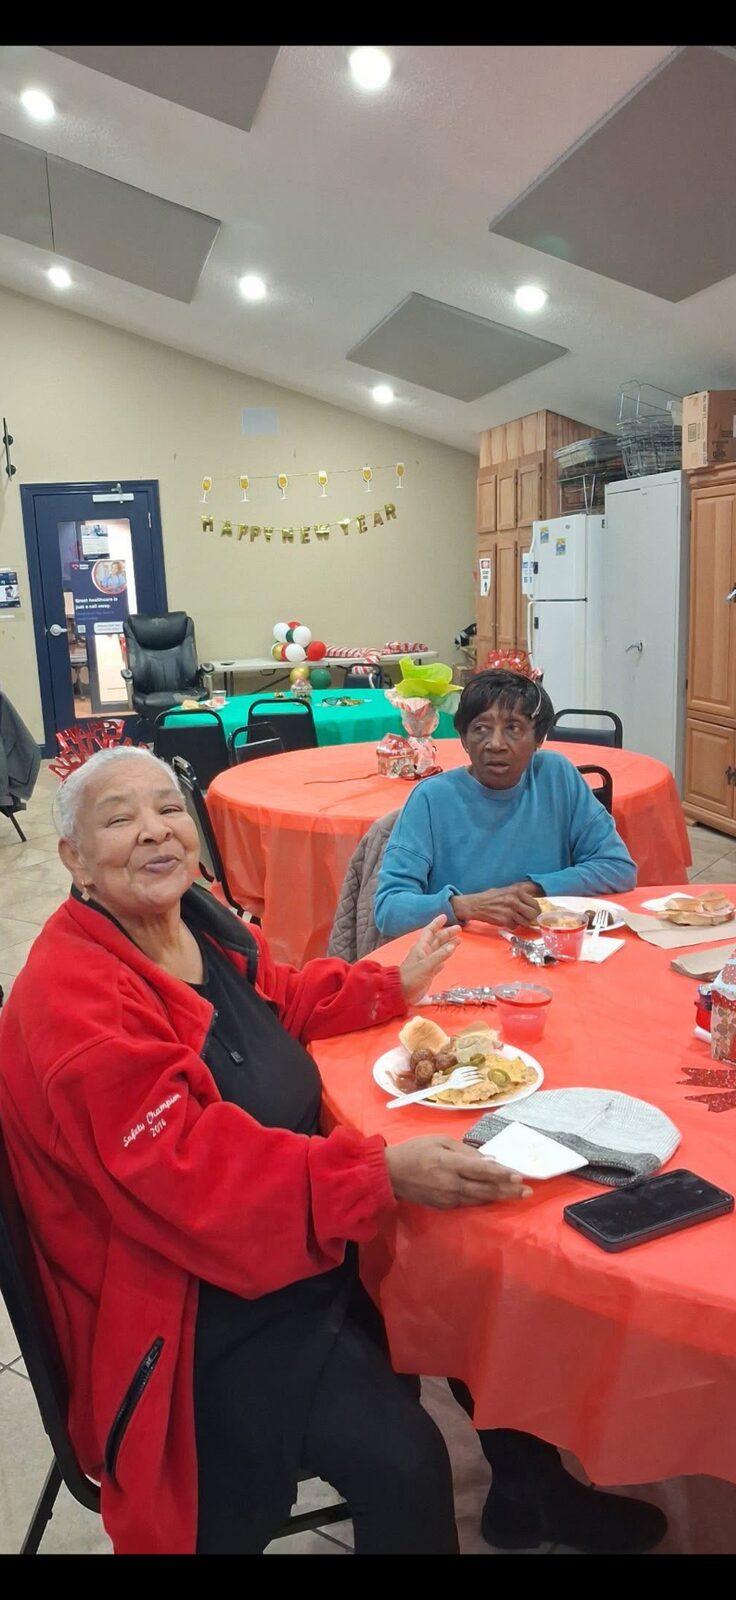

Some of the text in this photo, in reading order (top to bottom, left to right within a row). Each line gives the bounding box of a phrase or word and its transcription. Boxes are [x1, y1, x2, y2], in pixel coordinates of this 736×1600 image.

[200, 503, 397, 544] HAPPY NEW YEAR
[56, 719, 125, 753] HAPPY
[123, 1093, 181, 1147] Safety Champion
